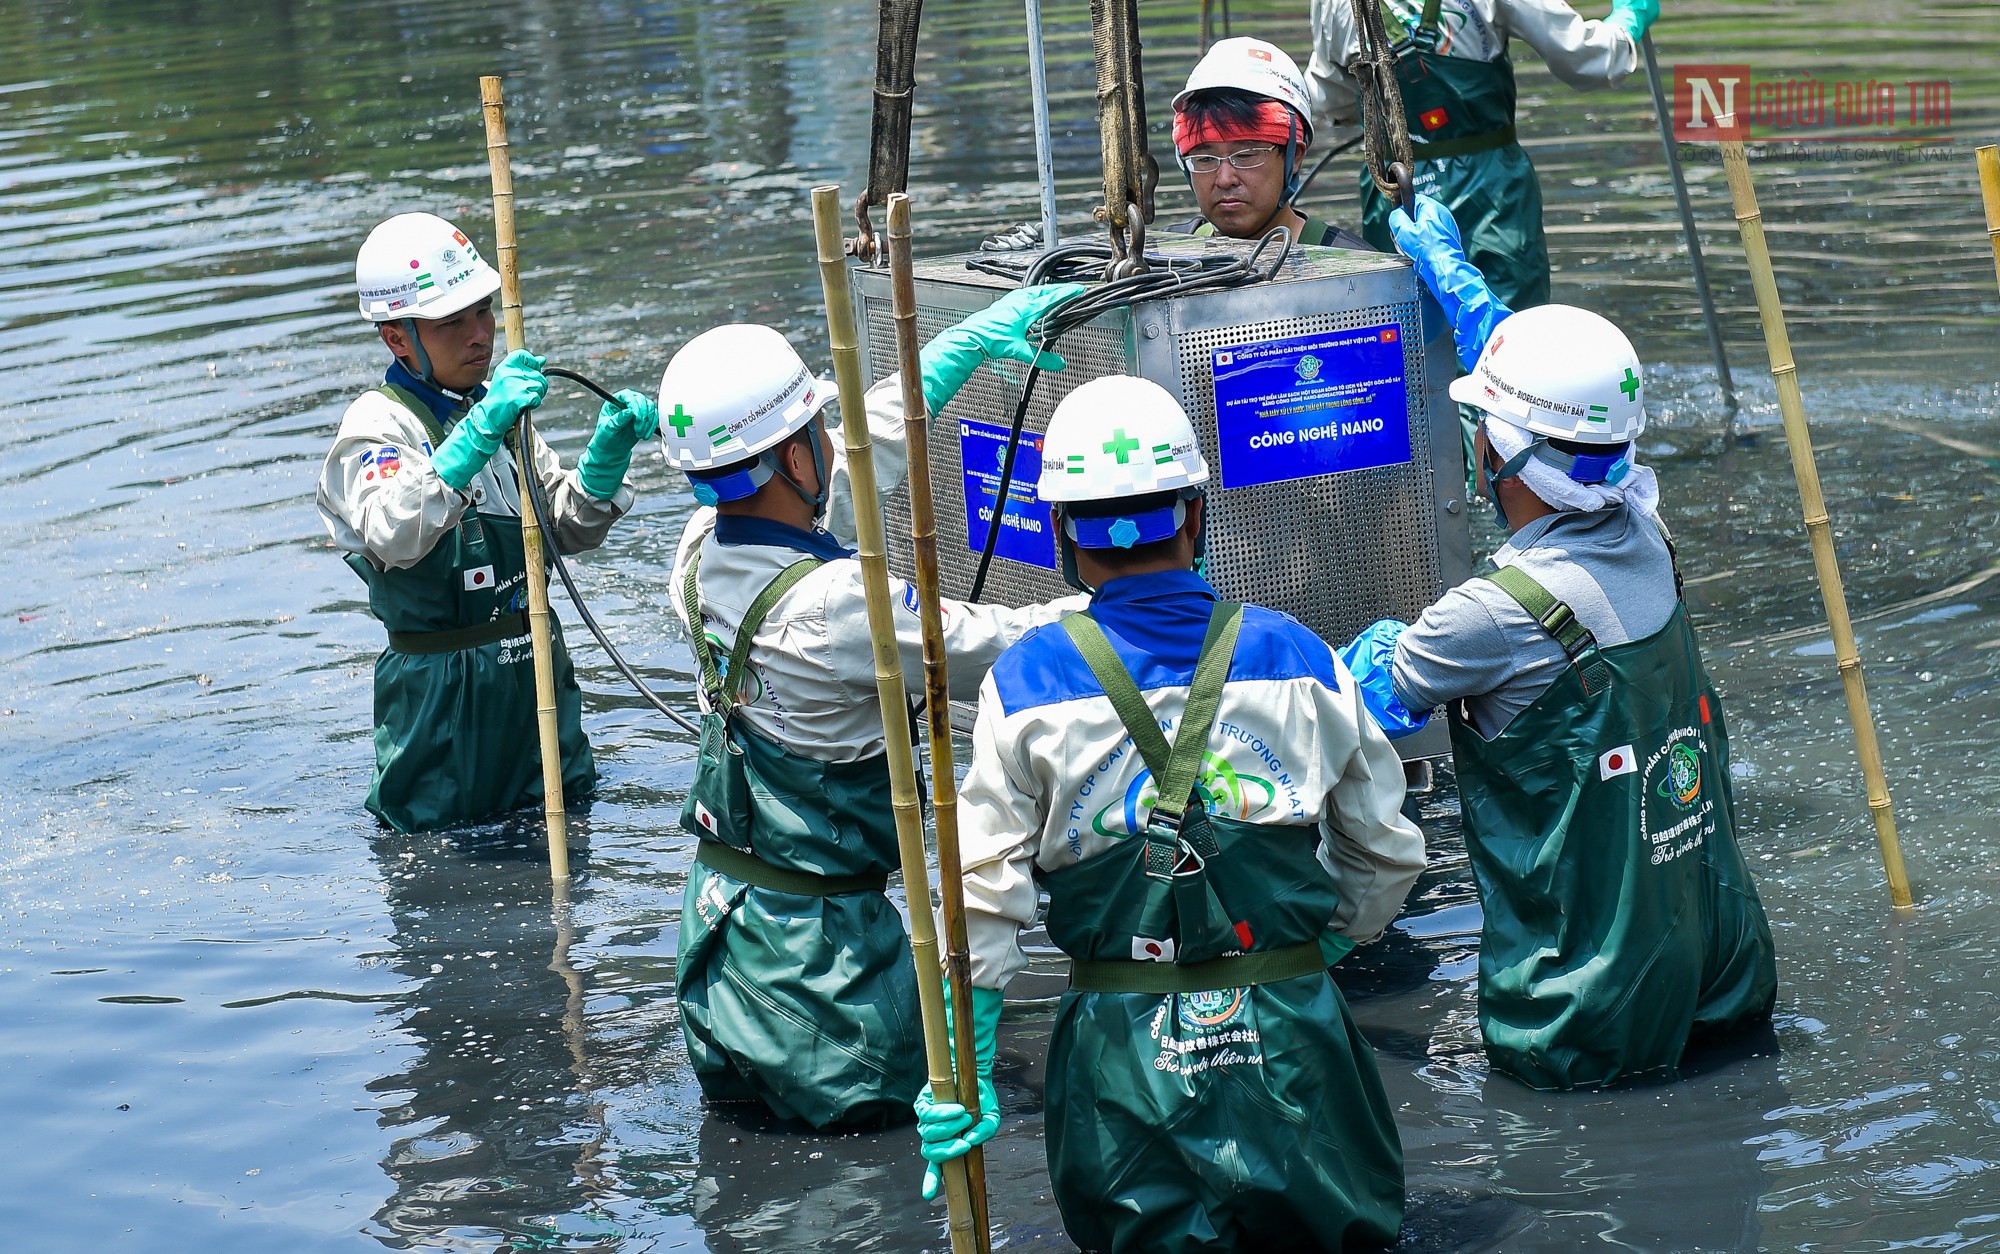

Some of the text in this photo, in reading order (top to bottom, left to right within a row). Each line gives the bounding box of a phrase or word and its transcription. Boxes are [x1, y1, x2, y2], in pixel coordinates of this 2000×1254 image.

[1500, 380, 1515, 395] NANO
[1516, 390, 1553, 409] BIOREACTOR
[1552, 402, 1570, 416] NHẬT
[1571, 404, 1585, 417] BẢN
[728, 421, 743, 434] CÔNG
[1250, 417, 1384, 449] CÔNG NGHỆ NANO
[1020, 516, 1042, 533] NANO
[1219, 721, 1282, 773] TRƯỜNG
[1070, 799, 1085, 821] TY
[1079, 774, 1097, 797] CP
[1151, 1005, 1167, 1040] CÔNG
[1210, 1047, 1246, 1068] thiên
